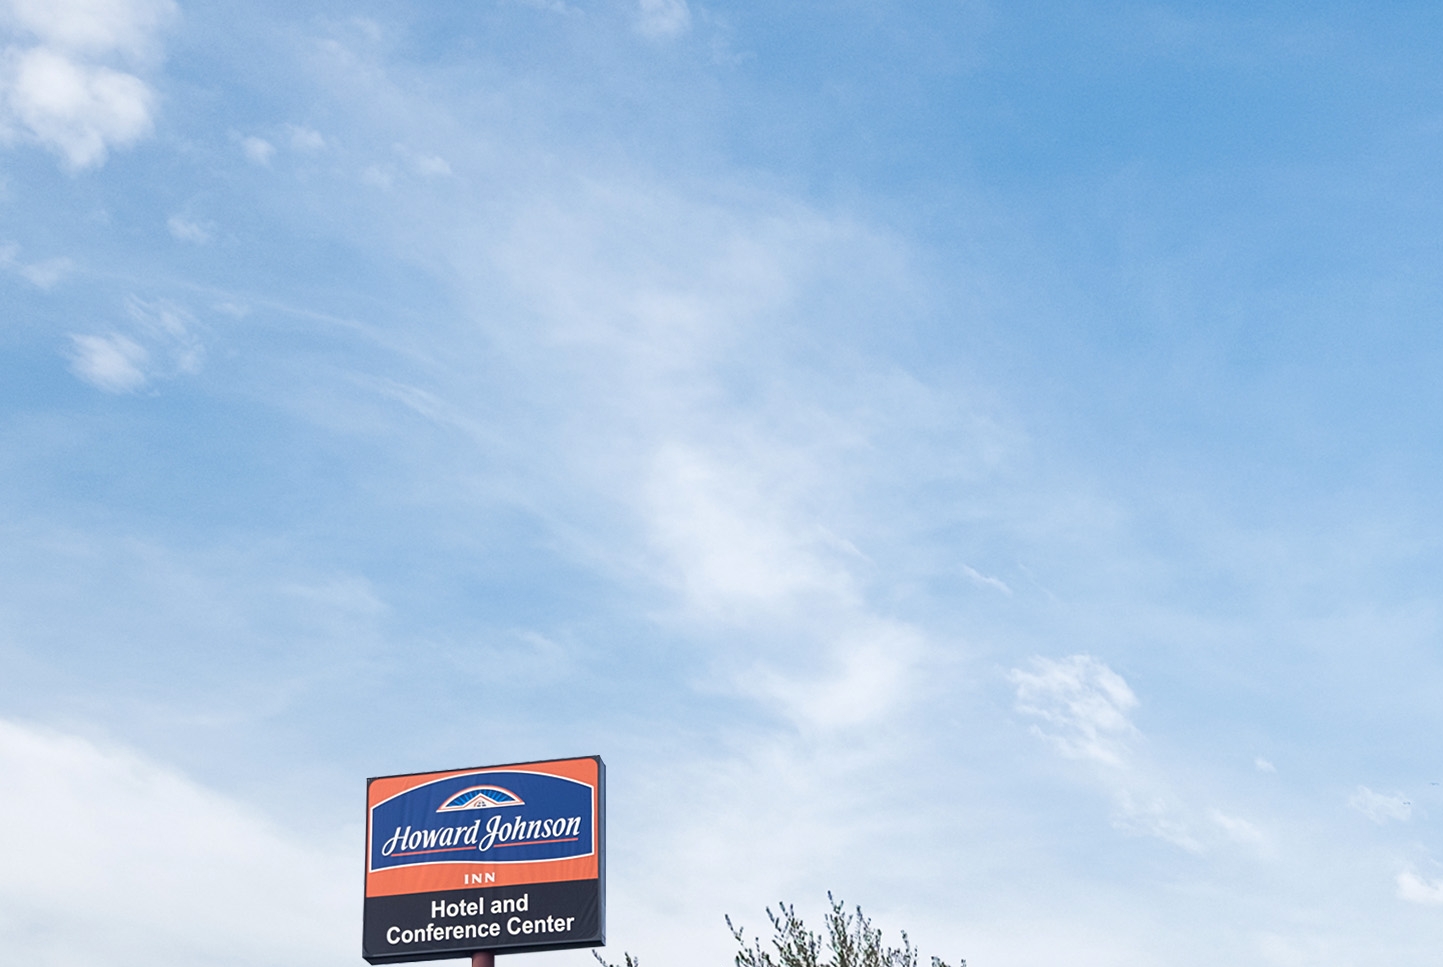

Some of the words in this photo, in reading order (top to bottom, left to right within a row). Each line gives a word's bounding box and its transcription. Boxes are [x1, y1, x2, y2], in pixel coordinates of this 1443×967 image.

[381, 819, 481, 857] Howard
[478, 815, 582, 852] Johnson
[464, 872, 496, 884] INN
[431, 897, 484, 918] Hotel
[490, 893, 529, 915] and
[386, 922, 501, 945] Conference
[506, 915, 575, 936] Center
